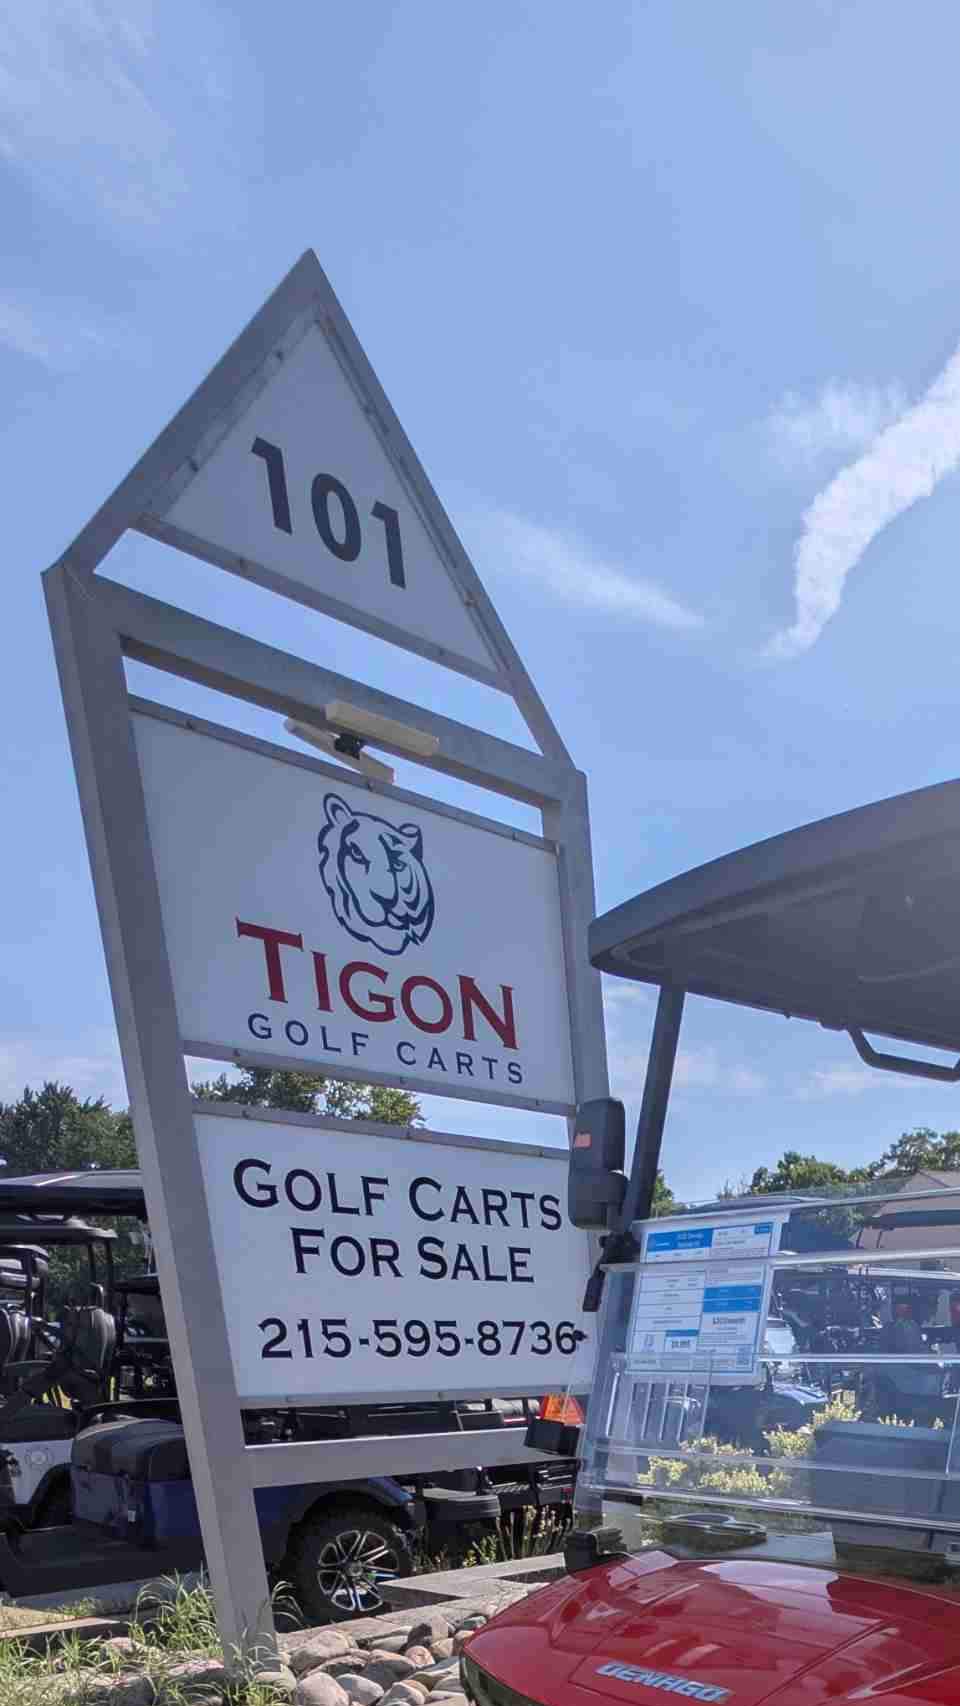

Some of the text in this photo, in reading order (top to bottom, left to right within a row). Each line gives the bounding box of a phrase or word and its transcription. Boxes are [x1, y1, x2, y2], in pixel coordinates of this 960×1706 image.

[251, 435, 406, 590] 101
[235, 916, 519, 1050] TIGON
[247, 1013, 524, 1085] GOLF CARTS
[233, 1158, 563, 1231] GOLF CARTS
[290, 1227, 535, 1283] FOR SALE
[258, 1317, 577, 1360] 215-595-8736
[595, 1662, 734, 1702] DENAGO
